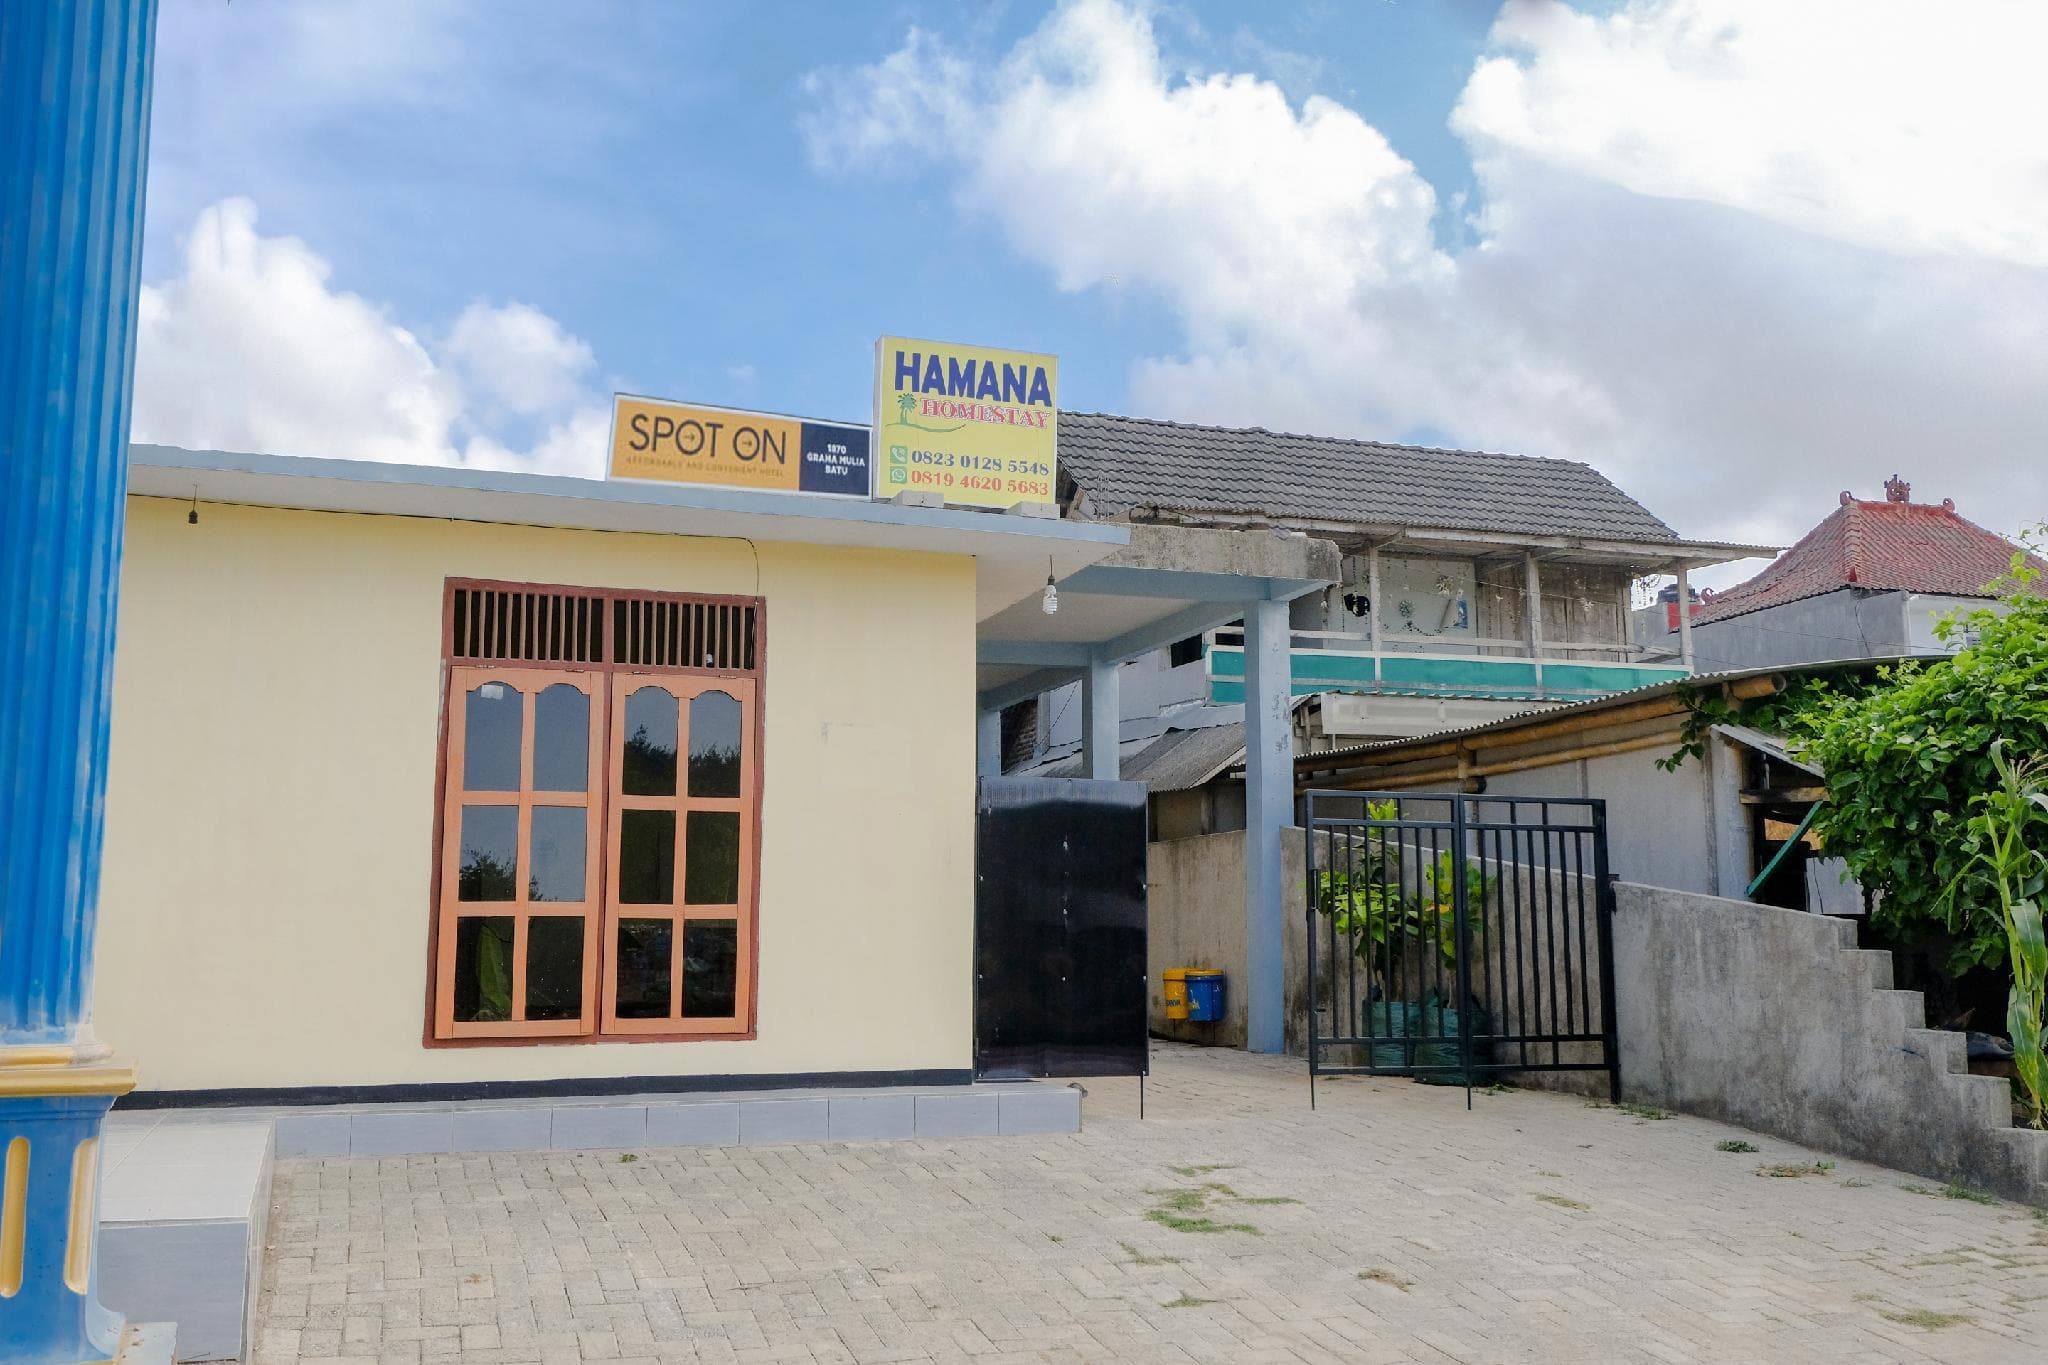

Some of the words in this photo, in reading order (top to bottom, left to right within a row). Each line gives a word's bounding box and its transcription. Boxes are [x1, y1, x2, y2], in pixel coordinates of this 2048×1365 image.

[895, 351, 1052, 407] HAMANA
[920, 398, 1051, 429] HOMESTAY
[629, 413, 723, 457] SPOT
[733, 427, 786, 464] ON
[807, 452, 837, 464] GRAHA
[839, 456, 865, 467] MULIA
[825, 465, 848, 476] BATU
[911, 450, 955, 467] 0823
[960, 455, 1002, 472] 0128
[1008, 460, 1050, 476] 5548
[911, 470, 954, 487] 0819
[960, 475, 1002, 491] 4620
[1007, 479, 1049, 496] 5683
